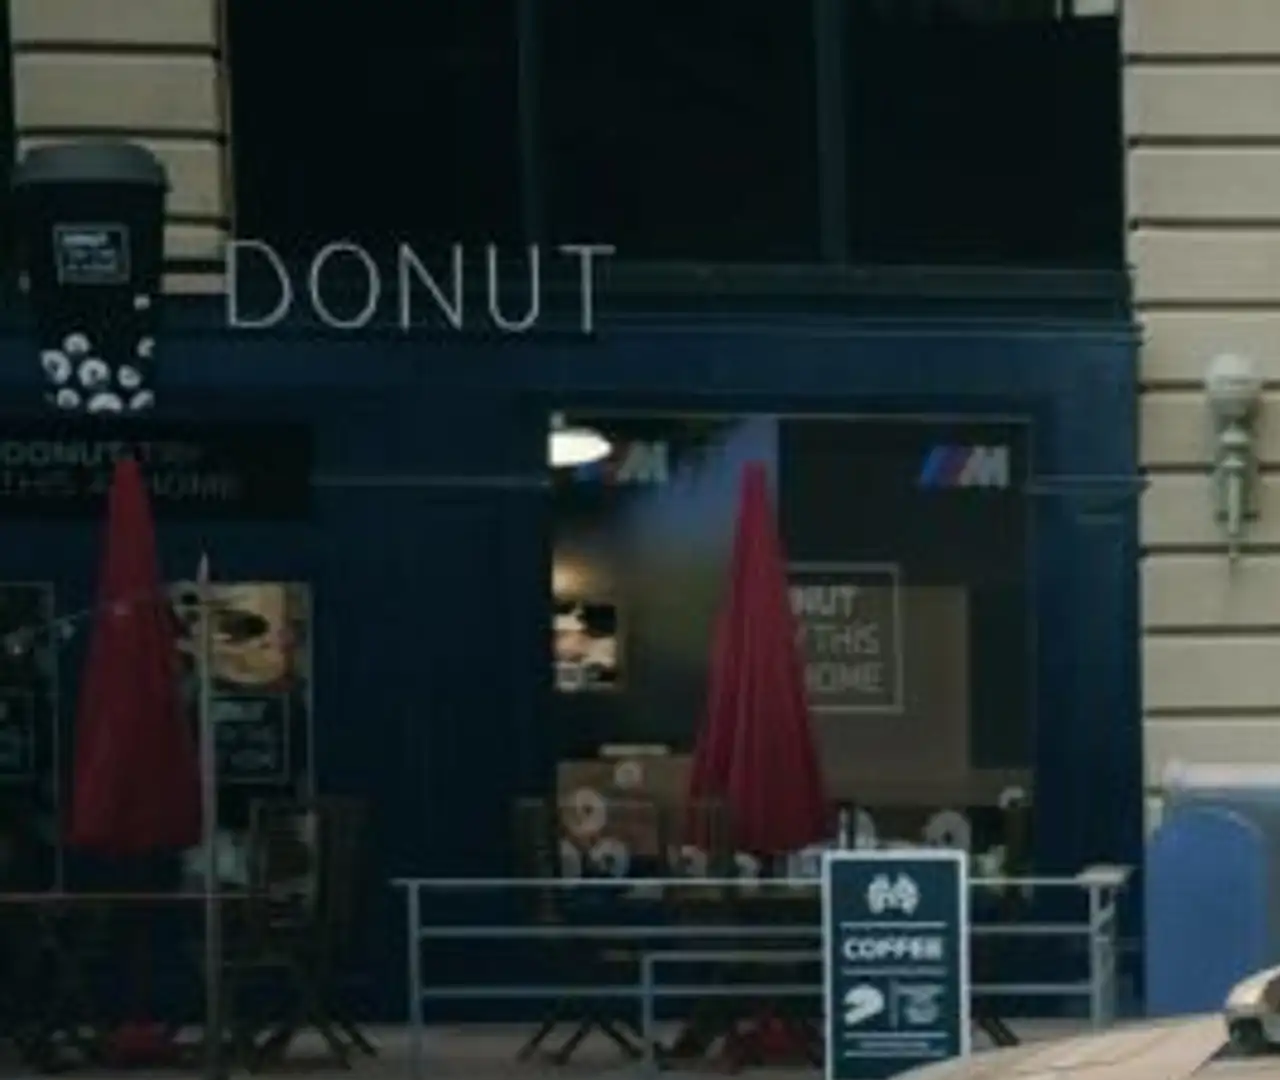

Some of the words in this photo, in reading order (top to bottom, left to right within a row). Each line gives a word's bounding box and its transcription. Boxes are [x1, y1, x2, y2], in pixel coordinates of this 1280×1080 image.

[224, 239, 617, 334] DONUT
[787, 585, 860, 618] NUT
[813, 623, 879, 654] THIS
[843, 936, 943, 960] COFFEE
